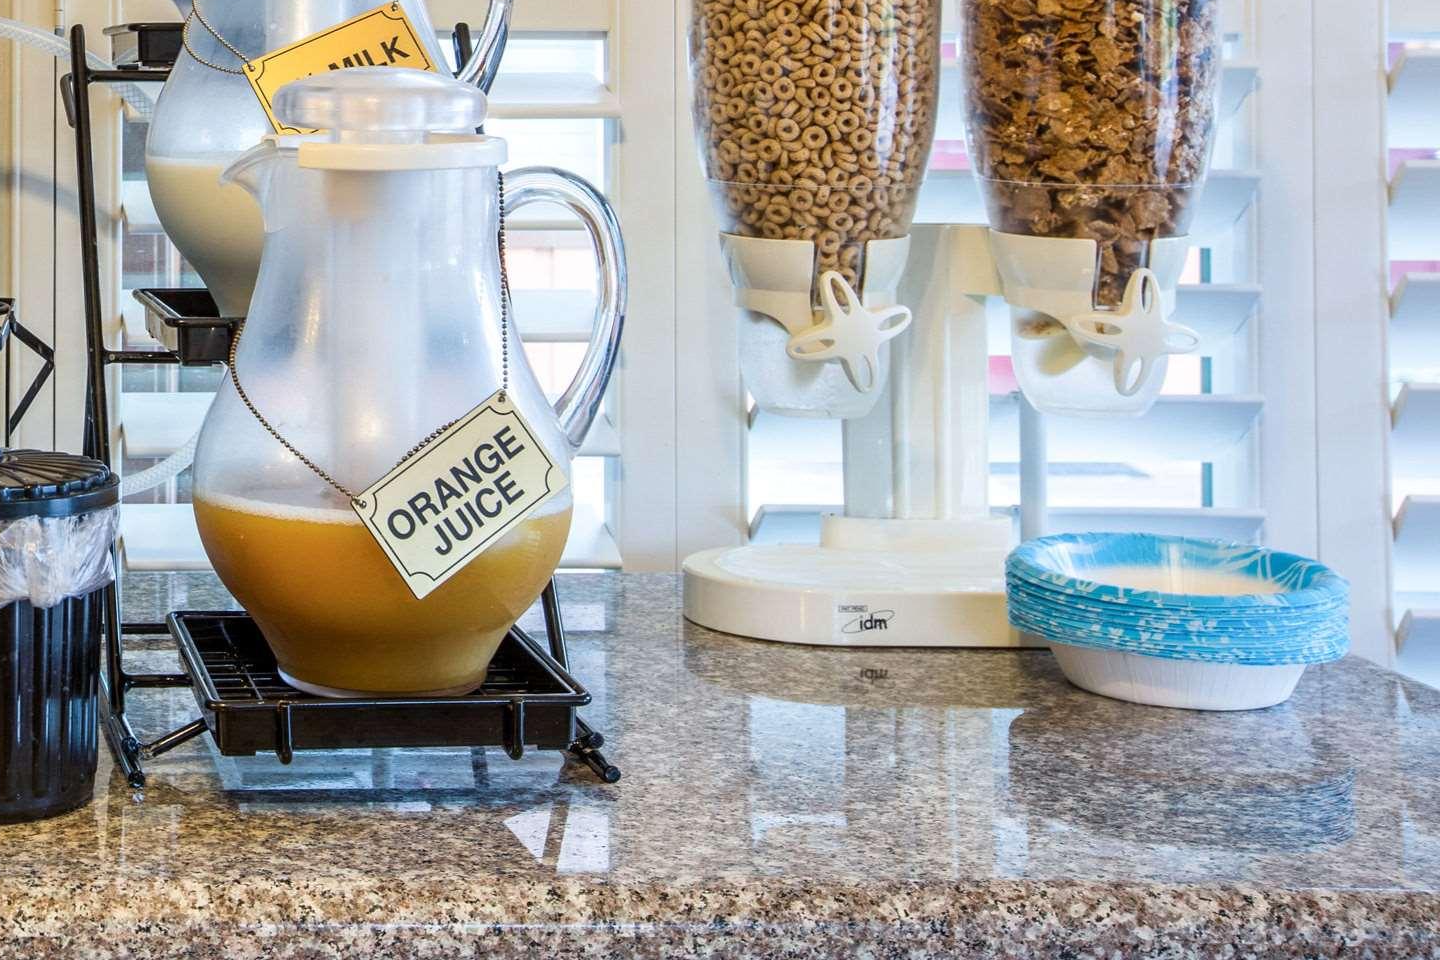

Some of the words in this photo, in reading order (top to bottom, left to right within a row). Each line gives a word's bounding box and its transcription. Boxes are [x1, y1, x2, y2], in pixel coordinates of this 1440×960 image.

[387, 425, 526, 540] ORANGE
[434, 470, 526, 556] JUICE
[859, 614, 888, 630] idm
